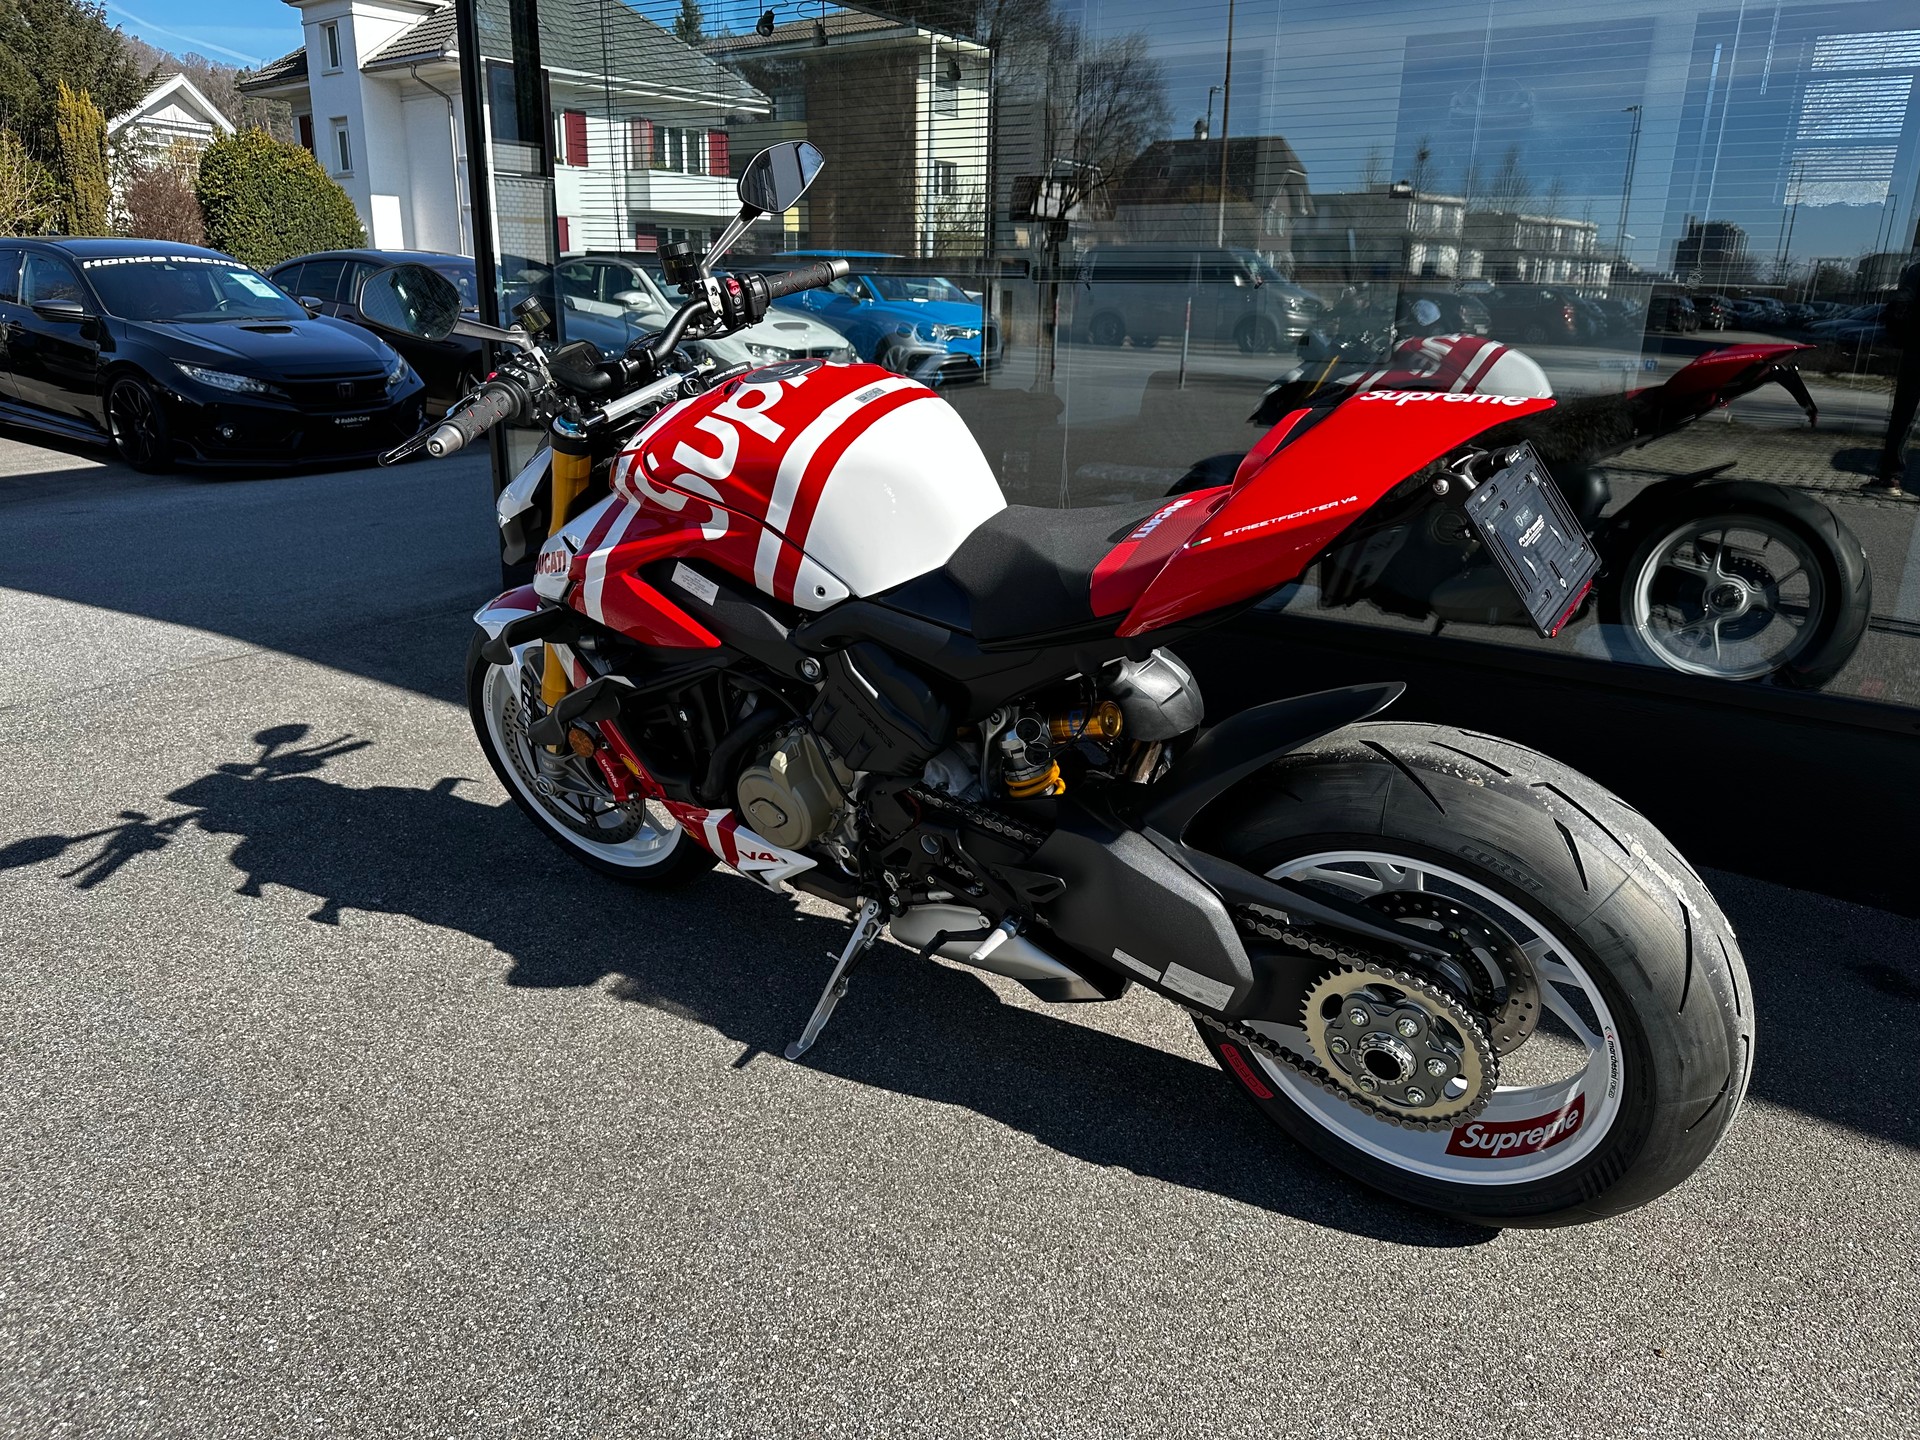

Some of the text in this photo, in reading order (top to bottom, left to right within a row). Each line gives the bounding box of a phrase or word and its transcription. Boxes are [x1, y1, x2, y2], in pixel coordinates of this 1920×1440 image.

[83, 255, 249, 270] Honda Racing
[1359, 389, 1529, 406] Supreme
[1131, 498, 1194, 539] DUCATI
[1223, 495, 1359, 537] STREETFIGHTER V4
[600, 759, 619, 788] brembo
[738, 850, 779, 863] V4
[1607, 1040, 1619, 1080] marchesini
[1458, 1107, 1580, 1157] Supreme
